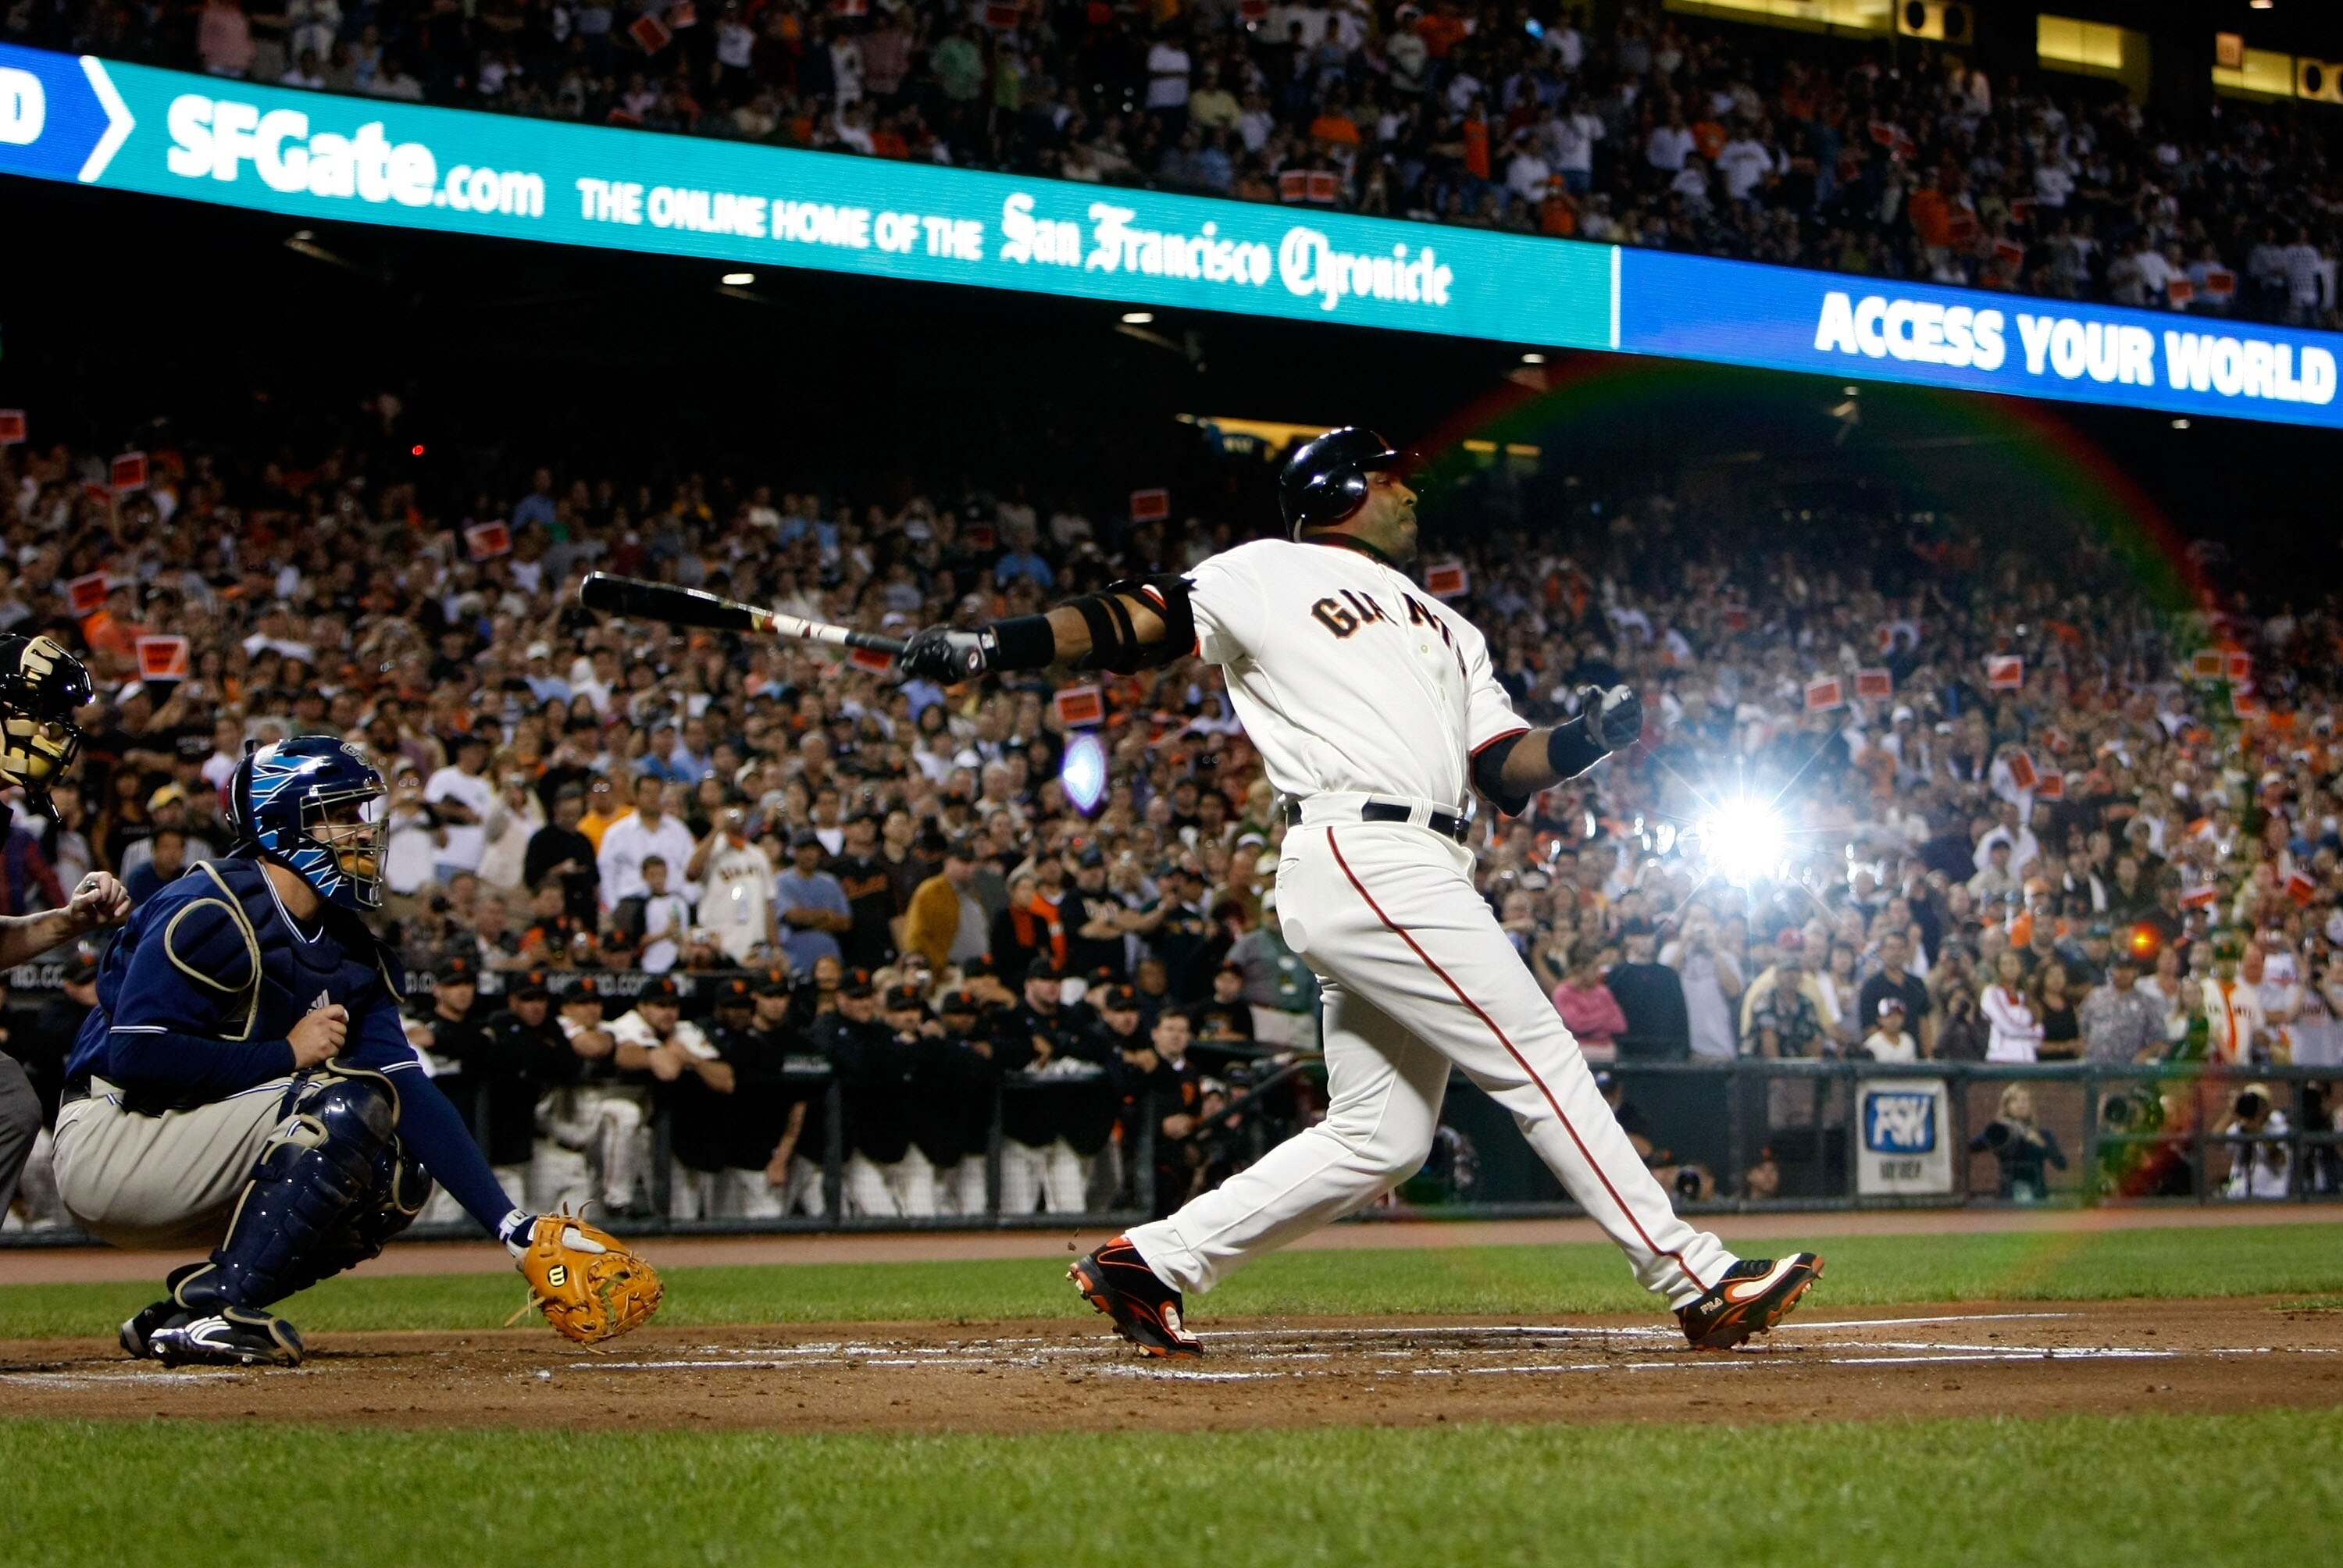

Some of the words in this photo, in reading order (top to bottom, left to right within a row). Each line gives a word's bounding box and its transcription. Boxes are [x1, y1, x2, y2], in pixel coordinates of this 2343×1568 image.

[167, 94, 544, 218] SFGate.com
[576, 177, 643, 226] THE
[647, 186, 767, 238] ONLINE
[771, 198, 871, 249] HOME
[874, 211, 920, 254] OF
[922, 215, 983, 261] THE
[1000, 192, 1082, 267] San
[1085, 201, 1272, 287] Francisco
[1278, 226, 1453, 311] Chronicle
[1813, 291, 2006, 371] ACCESS
[2016, 313, 2155, 386] YOUR
[2164, 330, 2337, 404] WORLD
[1699, 1296, 1724, 1315] FILA
